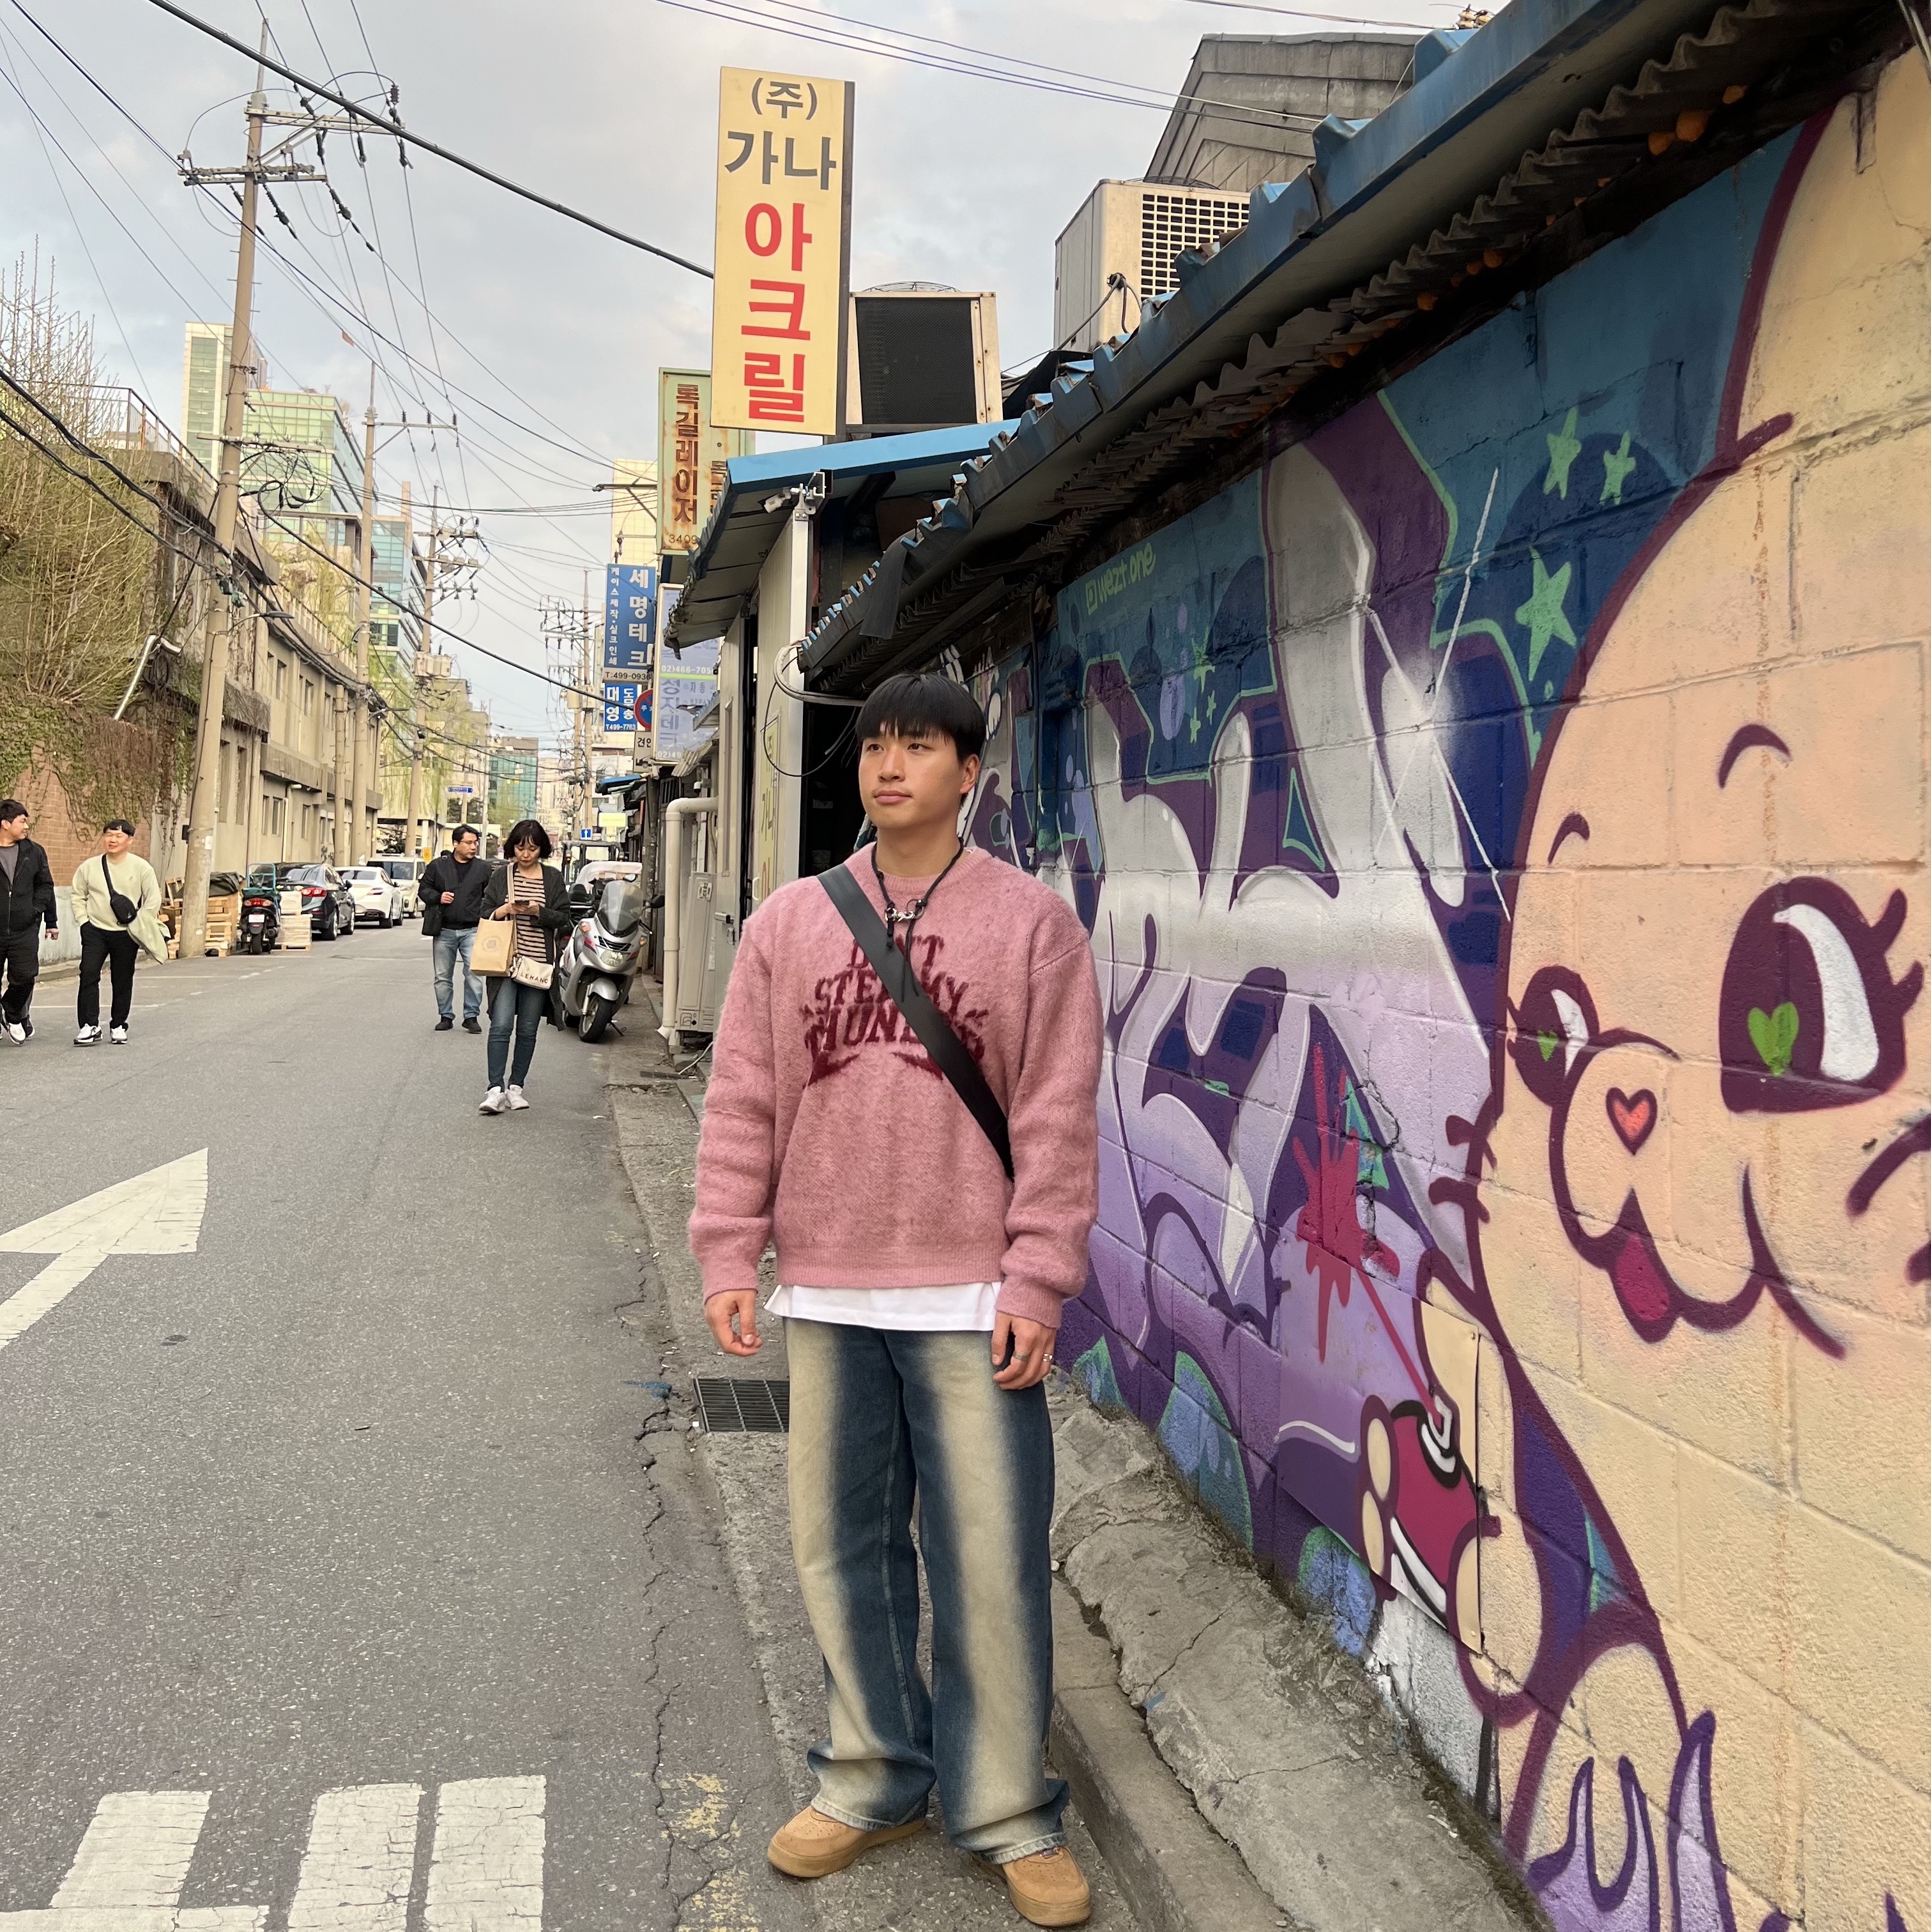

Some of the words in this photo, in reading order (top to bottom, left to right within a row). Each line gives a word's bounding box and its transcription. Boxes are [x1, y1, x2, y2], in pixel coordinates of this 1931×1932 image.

[751, 77, 818, 120] (주)
[724, 130, 837, 190] 가나
[741, 202, 813, 423] 아크릴
[627, 568, 649, 666] 세명테크
[606, 686, 620, 722] 대영
